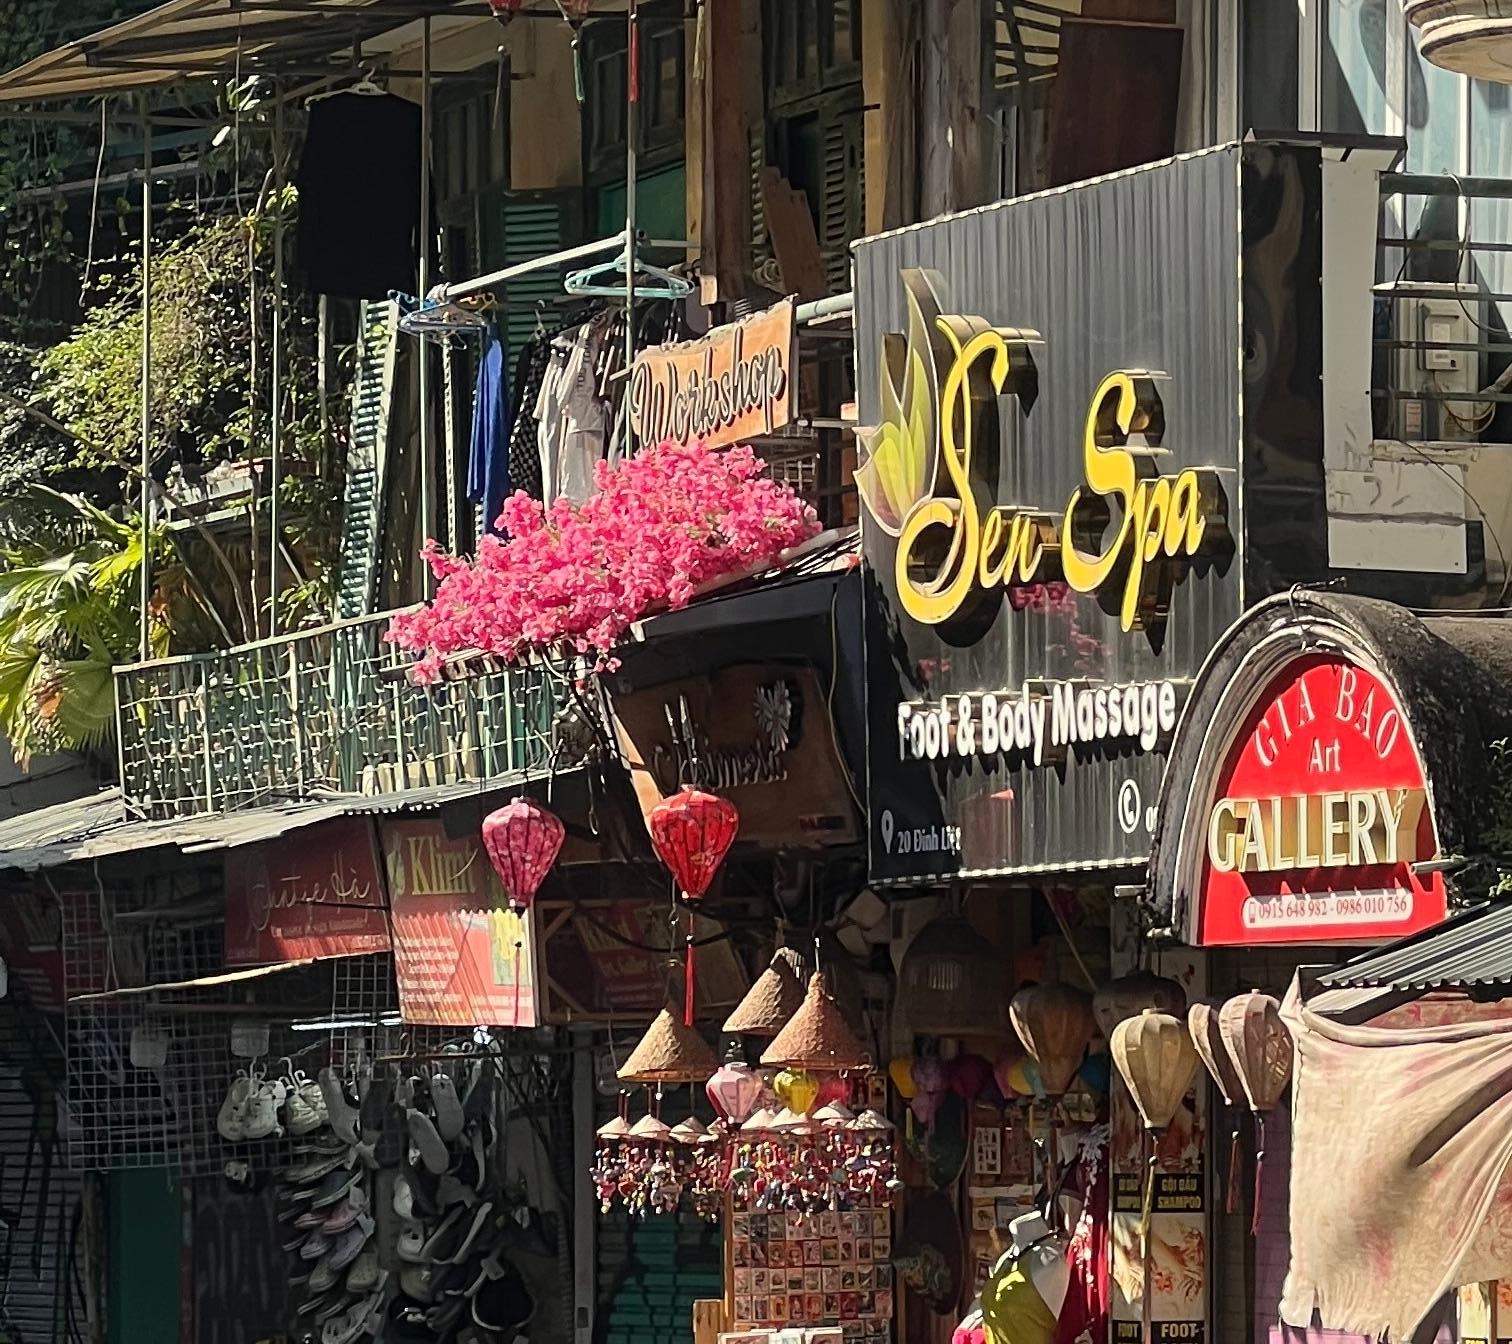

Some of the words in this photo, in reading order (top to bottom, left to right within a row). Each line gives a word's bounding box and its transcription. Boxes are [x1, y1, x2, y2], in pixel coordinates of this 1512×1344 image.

[631, 326, 787, 449] Workshop
[895, 315, 1043, 625] Sen
[1062, 370, 1206, 633] Spa
[898, 694, 950, 761] Foot
[956, 694, 976, 756] &
[982, 682, 1045, 767] Body
[1052, 680, 1176, 752] Massage
[1253, 677, 1316, 768] GIA
[1335, 664, 1400, 759] BAO
[1309, 737, 1342, 773] Art
[897, 831, 911, 853] 20
[1207, 788, 1410, 874] GALLERY
